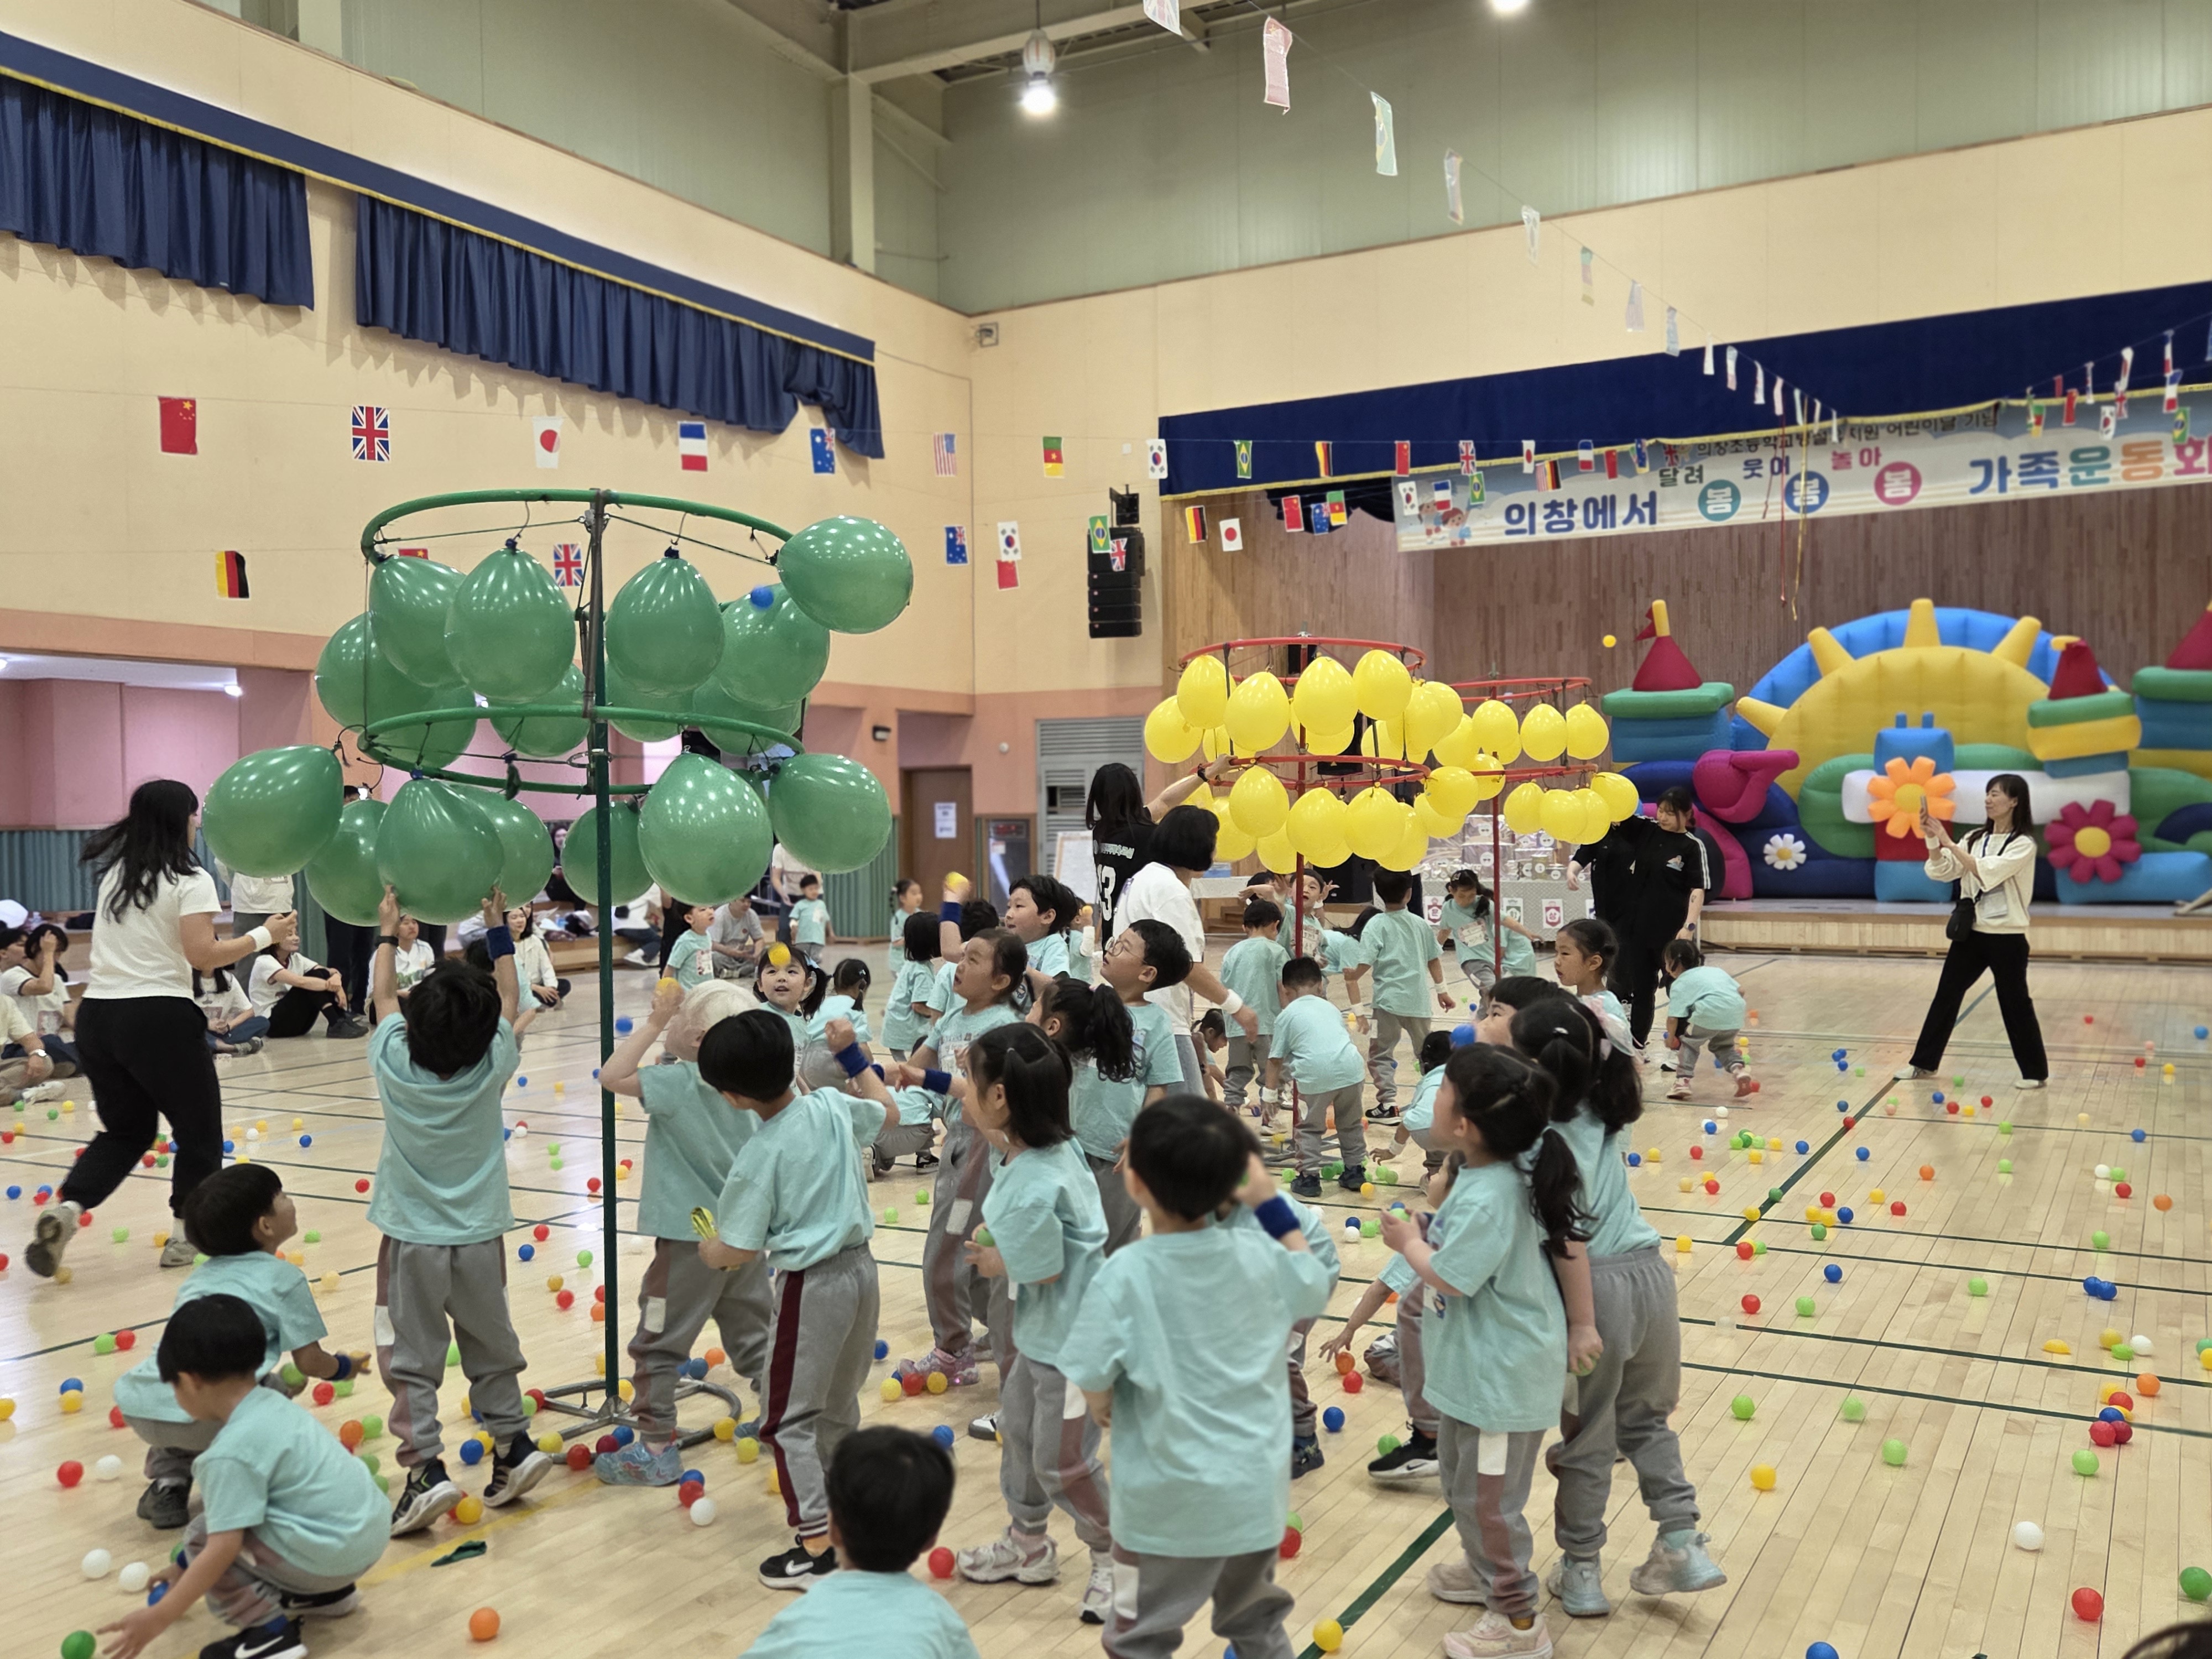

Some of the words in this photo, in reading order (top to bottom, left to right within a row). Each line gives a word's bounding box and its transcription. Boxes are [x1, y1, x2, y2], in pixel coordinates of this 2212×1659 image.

[1660, 465, 1704, 487] 달려
[1706, 487, 1733, 513] 봄
[1743, 456, 1790, 479] 웃어
[1832, 447, 1882, 471] 놀아
[1883, 469, 1912, 498] 봄
[1505, 490, 1657, 535] 의창에서
